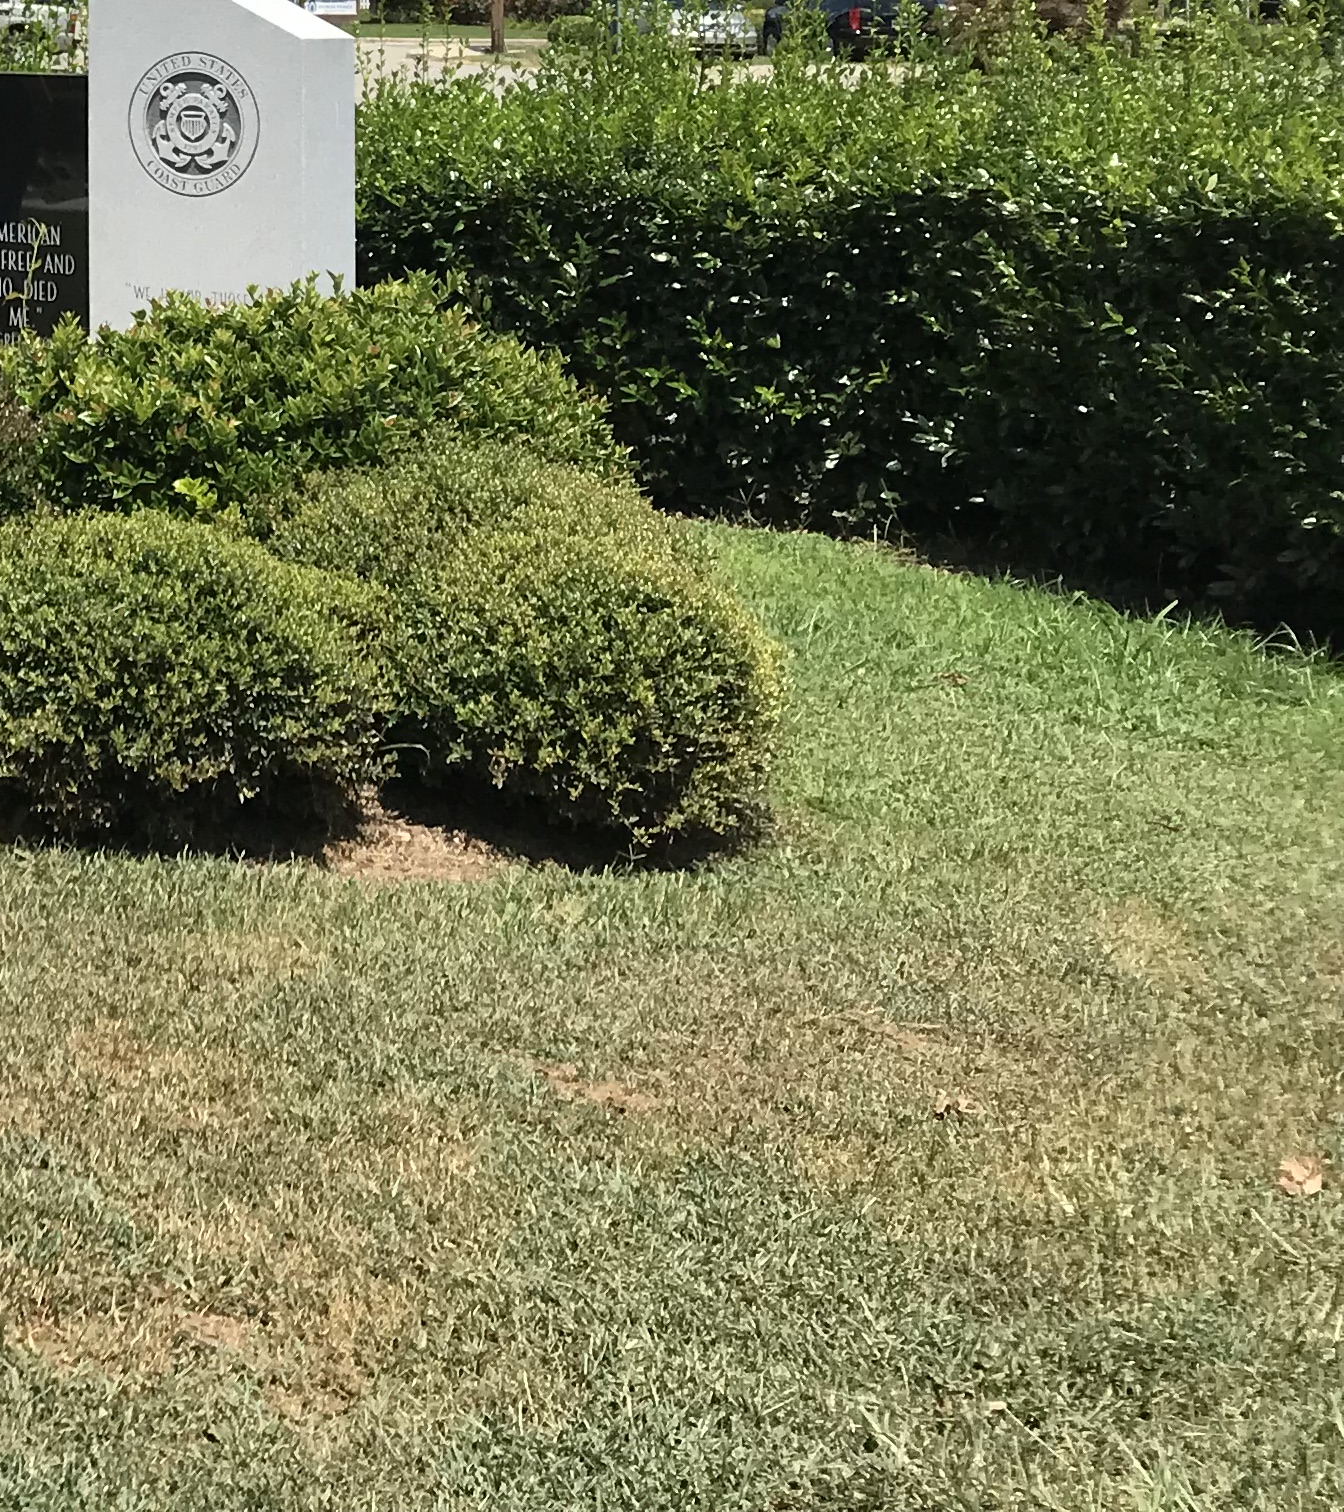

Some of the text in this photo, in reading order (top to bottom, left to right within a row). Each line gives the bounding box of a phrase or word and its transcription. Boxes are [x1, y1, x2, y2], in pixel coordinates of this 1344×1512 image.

[138, 55, 249, 100] UNITED STATES
[147, 160, 241, 194] COAST GUARD
[0, 249, 33, 272] FREE
[44, 253, 76, 276] AND
[23, 279, 57, 302] DIED
